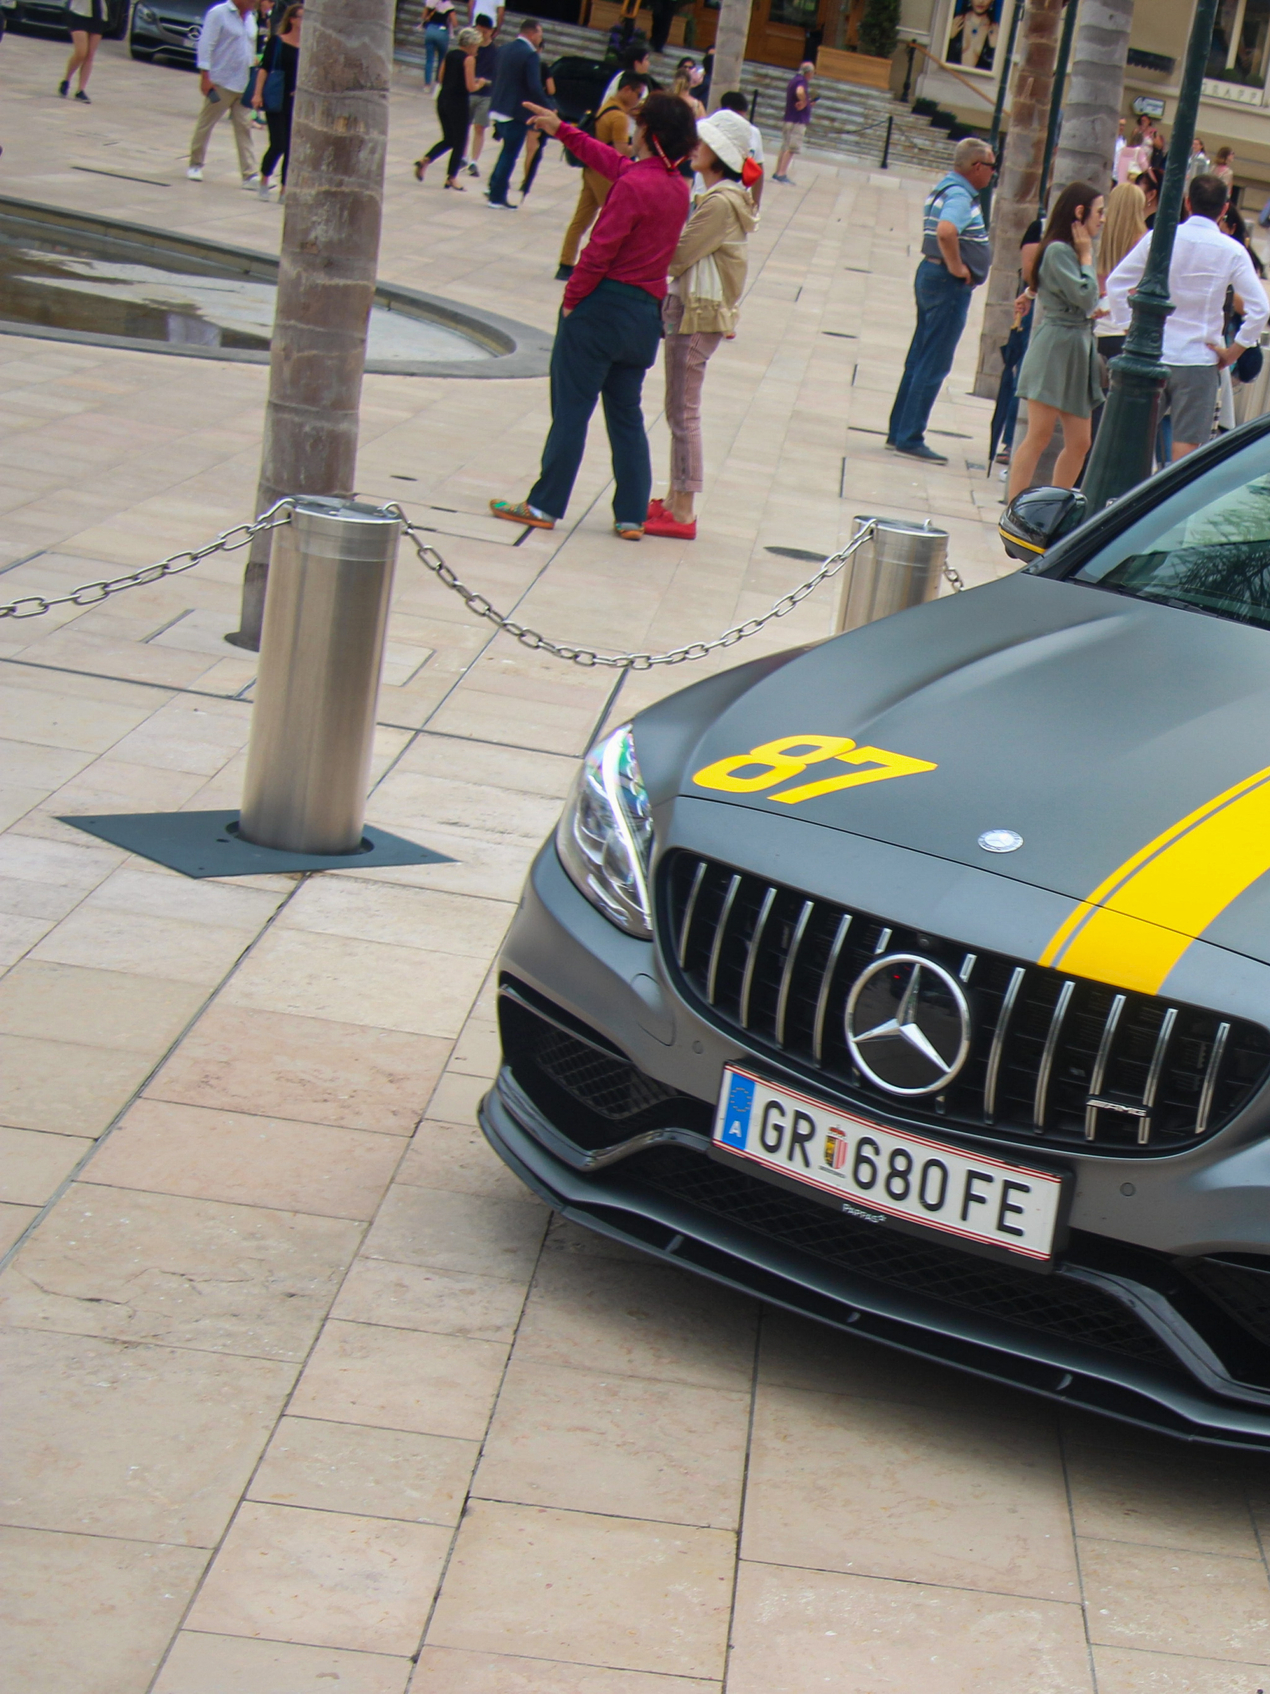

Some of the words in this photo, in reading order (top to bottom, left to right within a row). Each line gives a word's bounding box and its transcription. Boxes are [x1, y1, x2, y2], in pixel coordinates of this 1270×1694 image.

[692, 734, 938, 804] 87
[728, 1120, 742, 1138] A
[760, 1100, 816, 1168] GR
[852, 1136, 949, 1212] 680
[961, 1168, 1031, 1237] FE
